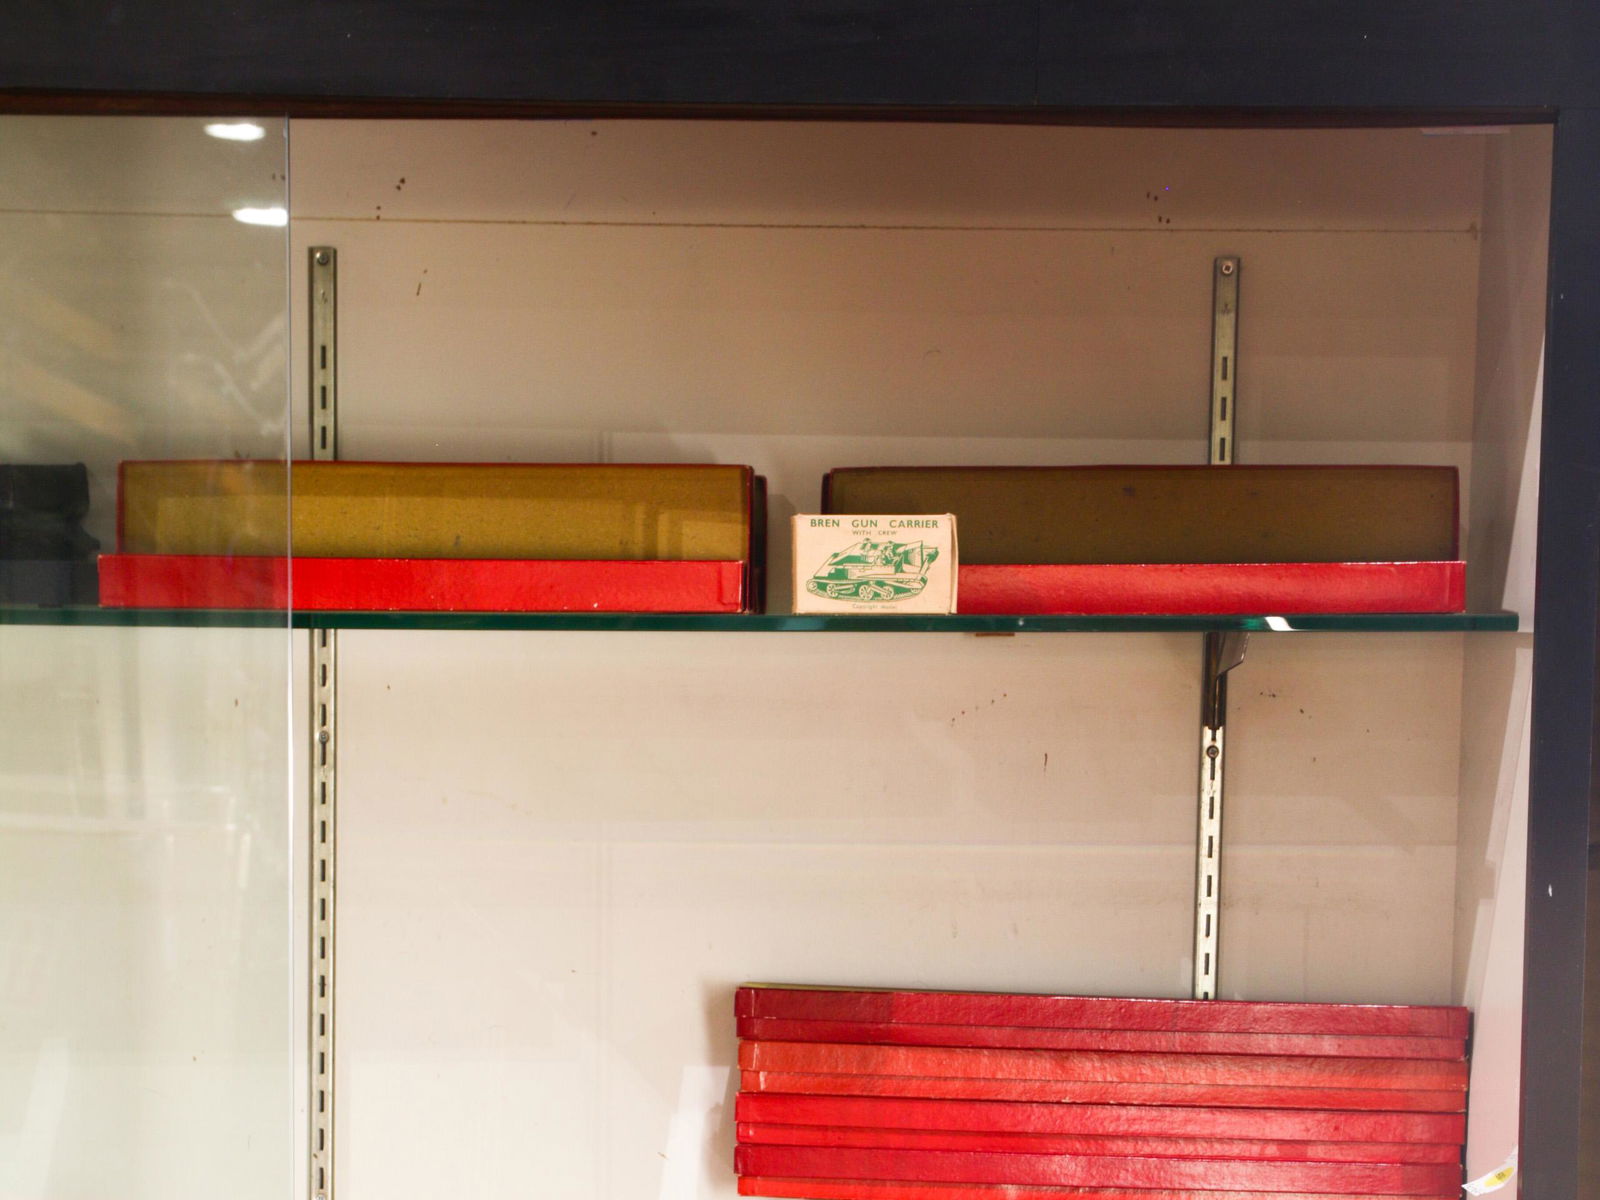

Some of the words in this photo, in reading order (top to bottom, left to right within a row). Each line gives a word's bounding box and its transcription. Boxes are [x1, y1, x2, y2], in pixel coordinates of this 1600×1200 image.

[810, 519, 840, 528] BREN
[851, 519, 878, 528] GUN
[889, 520, 939, 529] CARRIER
